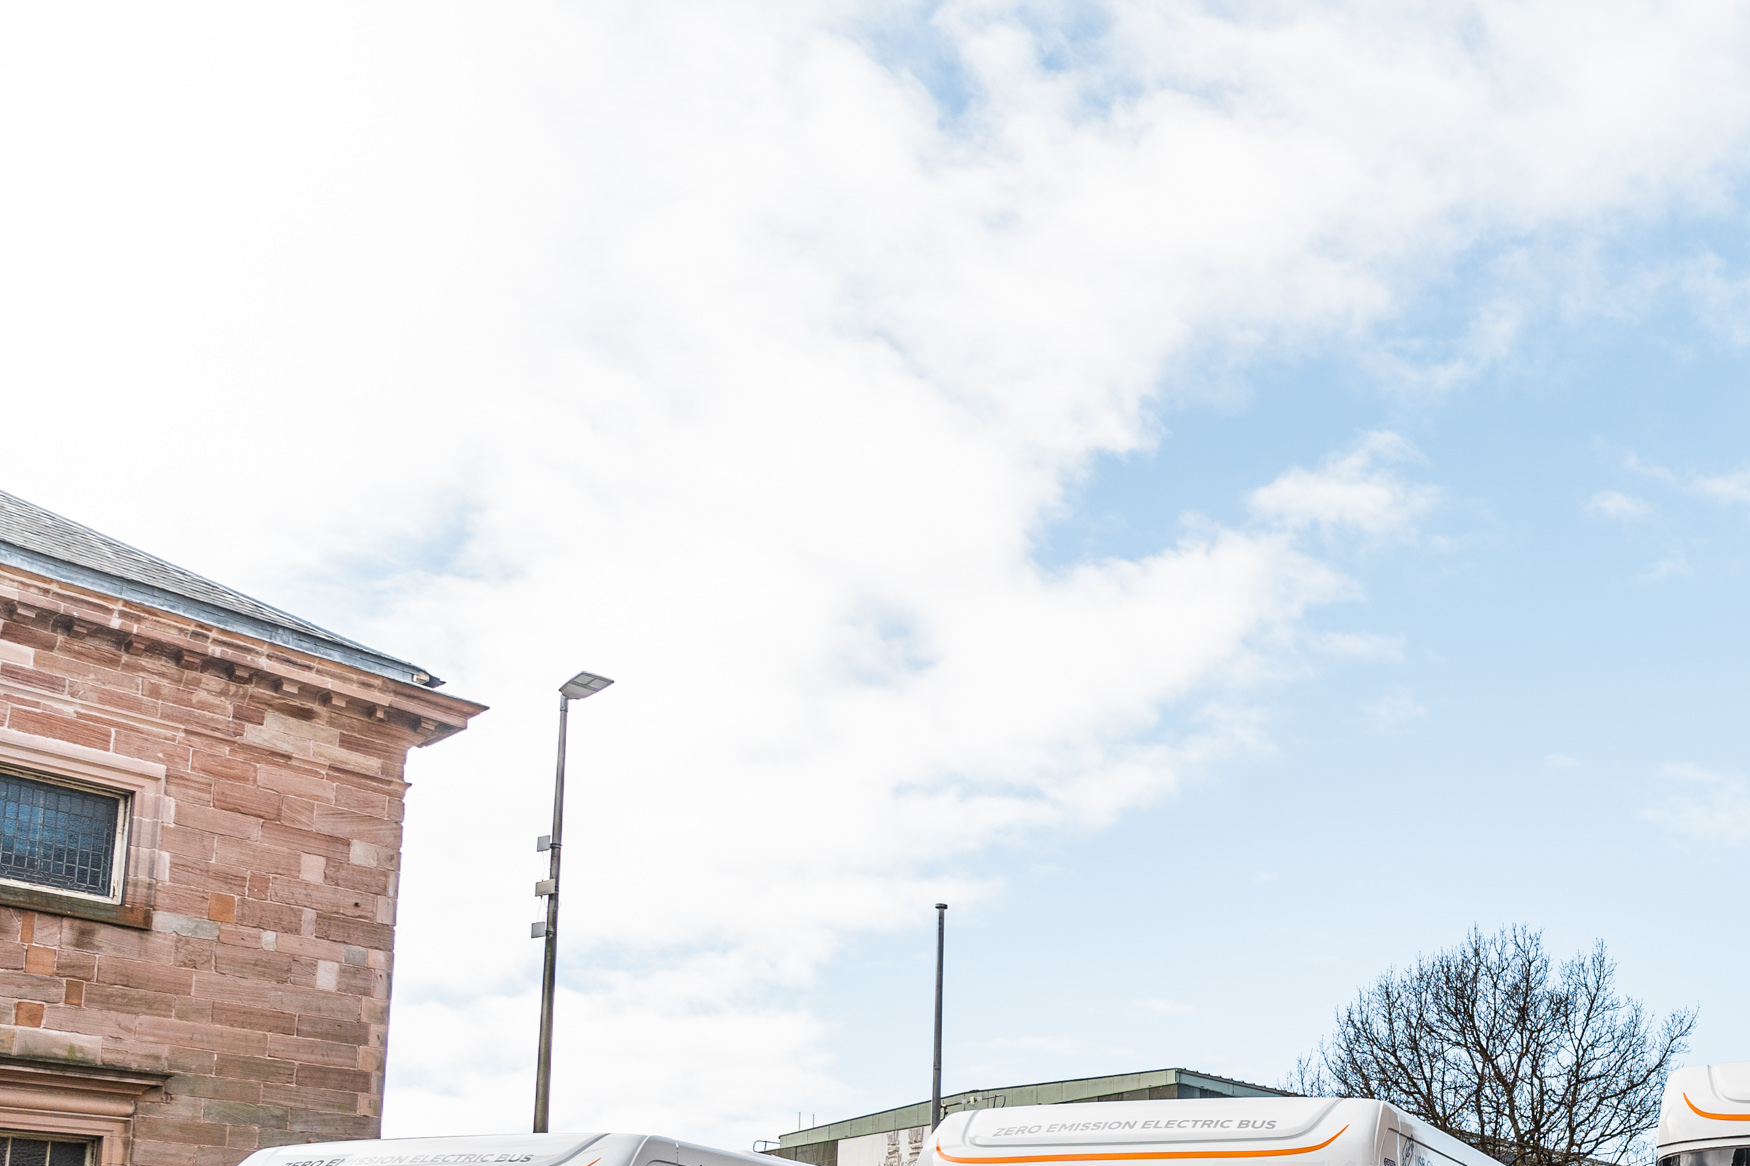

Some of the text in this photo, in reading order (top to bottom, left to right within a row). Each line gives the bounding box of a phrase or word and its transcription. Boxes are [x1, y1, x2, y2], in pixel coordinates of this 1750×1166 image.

[993, 1119, 1277, 1137] ZERO EMISSION ELECTRIC BUS
[408, 1153, 490, 1164] ELECTRIC
[494, 1153, 535, 1163] BUS
